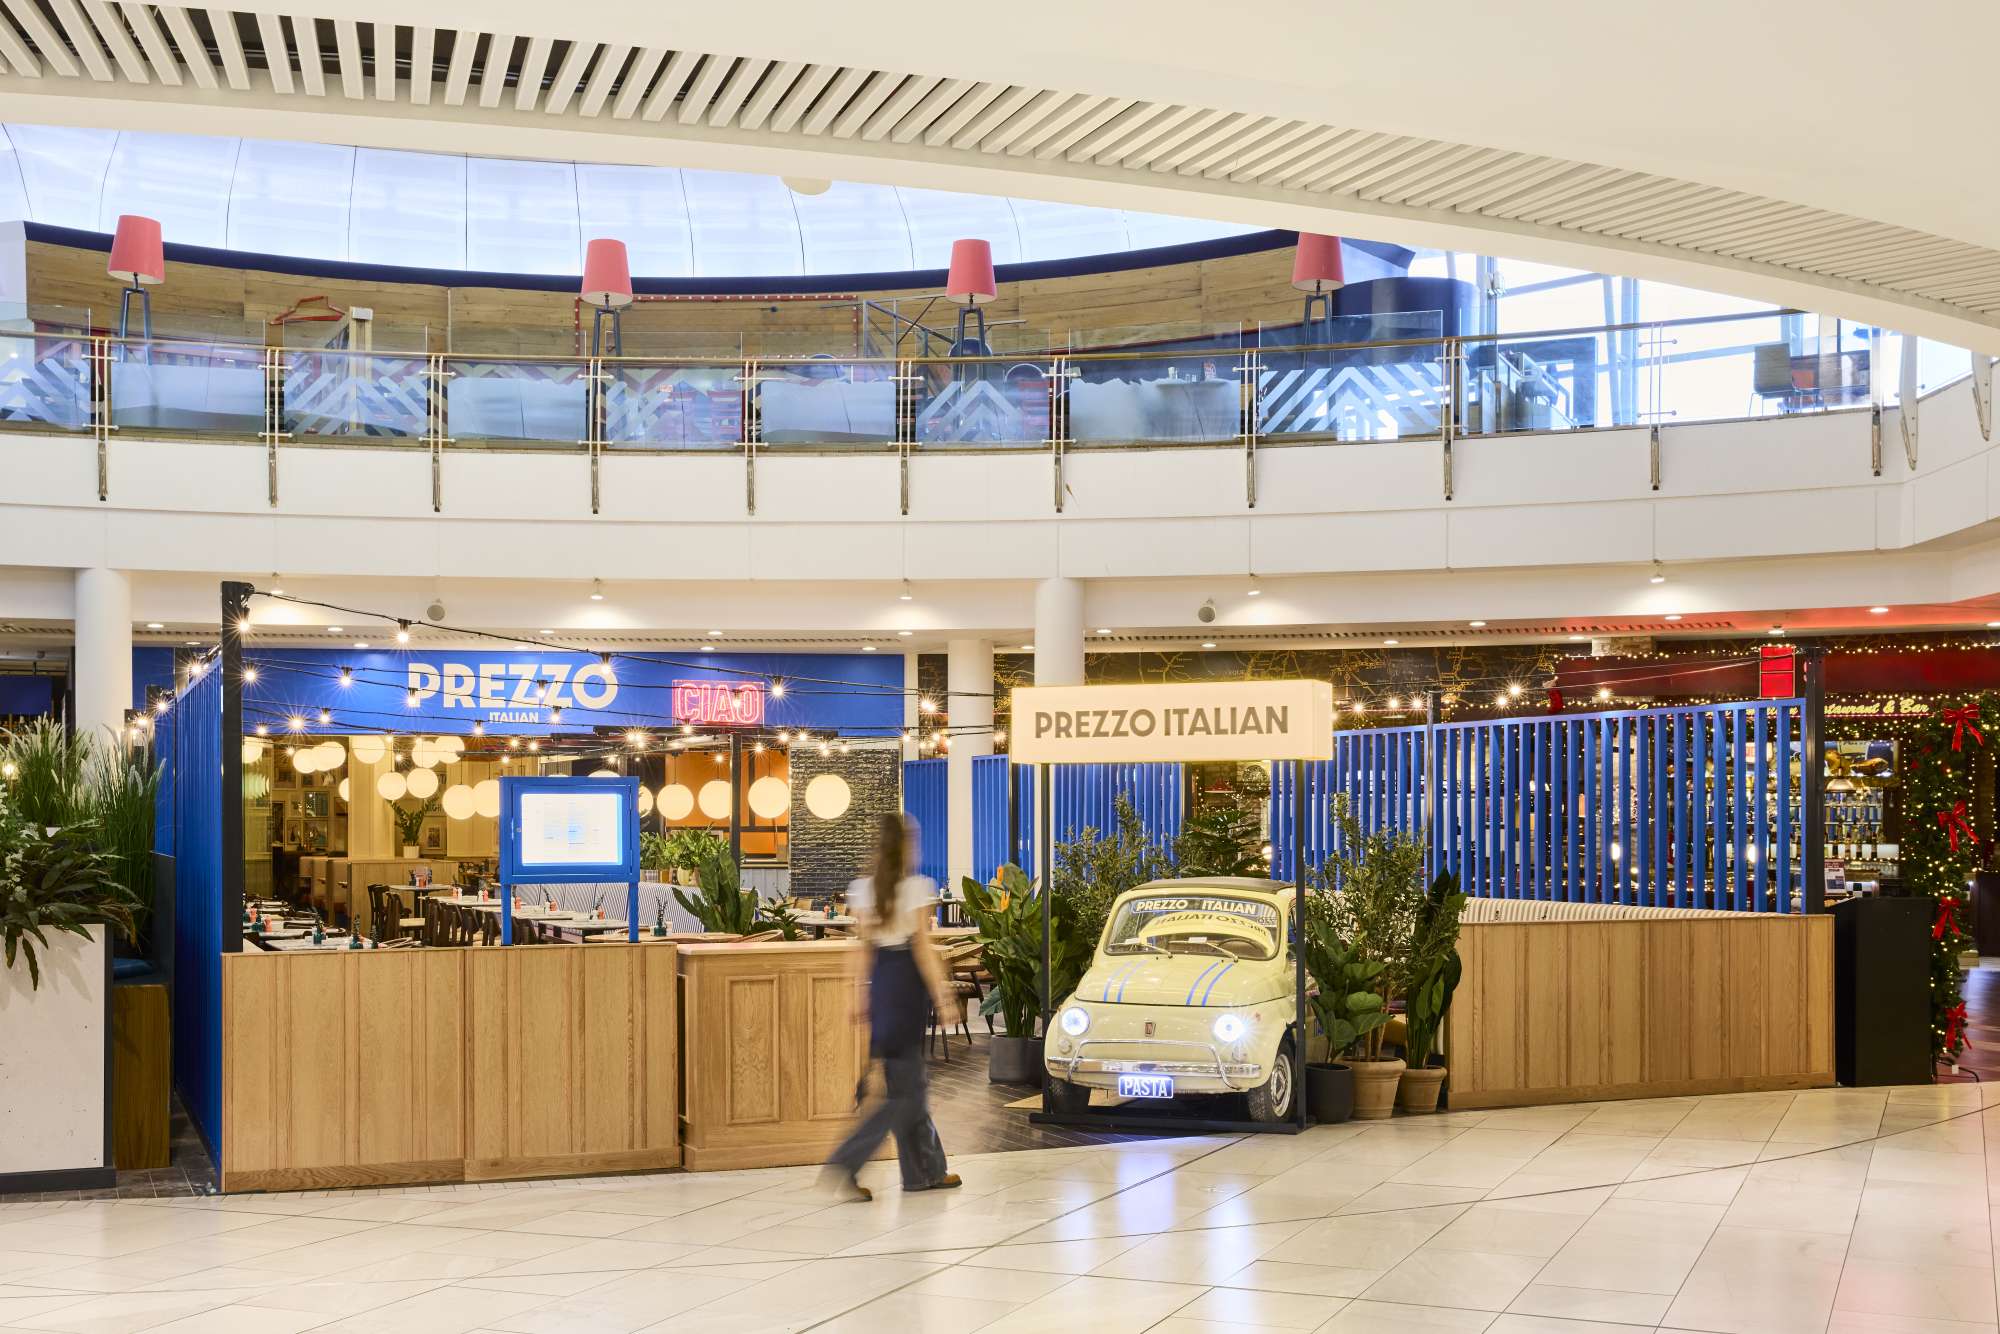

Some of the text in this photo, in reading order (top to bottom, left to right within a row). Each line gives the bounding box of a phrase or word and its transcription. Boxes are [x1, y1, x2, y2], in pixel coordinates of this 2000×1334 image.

[408, 663, 617, 708] PREZZO
[675, 681, 762, 723] CIAO
[1883, 700, 1895, 713] &
[1900, 699, 1929, 713] Bar
[489, 712, 539, 723] ITALIAN
[1035, 705, 1288, 738] PREZZO ITALIAN
[1136, 900, 1256, 914] PREZZO ITALIAN
[1124, 1078, 1168, 1097] PASTA
